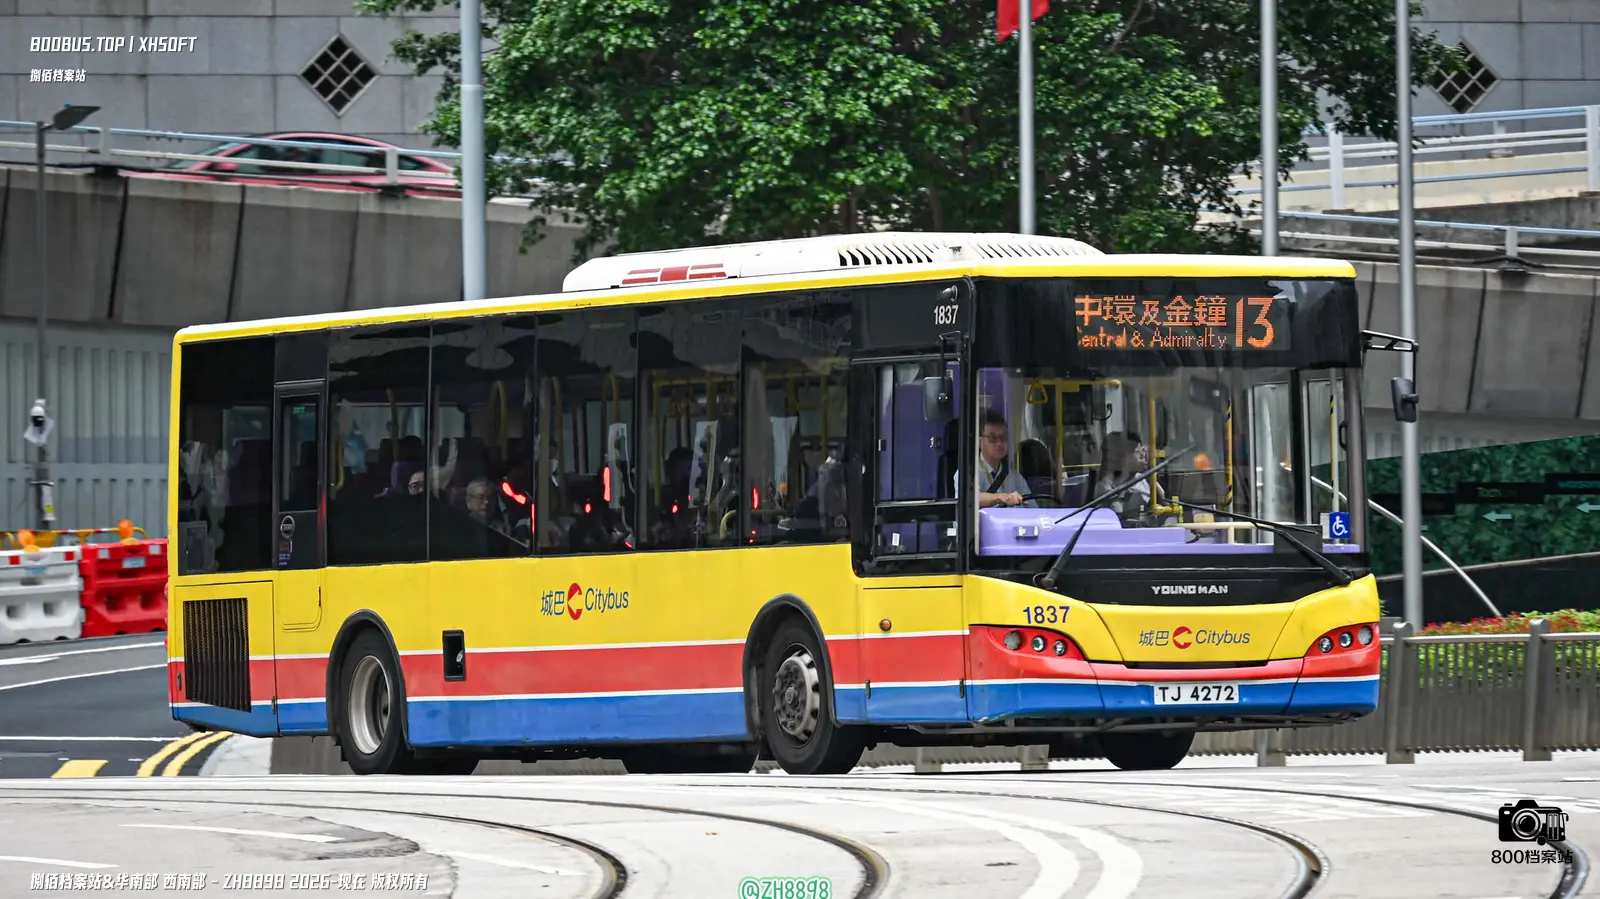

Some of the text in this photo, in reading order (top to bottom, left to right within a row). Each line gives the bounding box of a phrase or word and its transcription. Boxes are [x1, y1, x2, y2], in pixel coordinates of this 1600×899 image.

[933, 304, 959, 325] 1837
[1075, 295, 1275, 348] 中環及金鐘 13
[1130, 330, 1146, 348] &
[1150, 326, 1228, 348] Admiralty
[541, 586, 629, 616] 城巴 Citybus
[1023, 605, 1071, 625] 1837
[1138, 629, 1251, 646] 城巴 Citybus
[1158, 685, 1235, 702] TJ 4272
